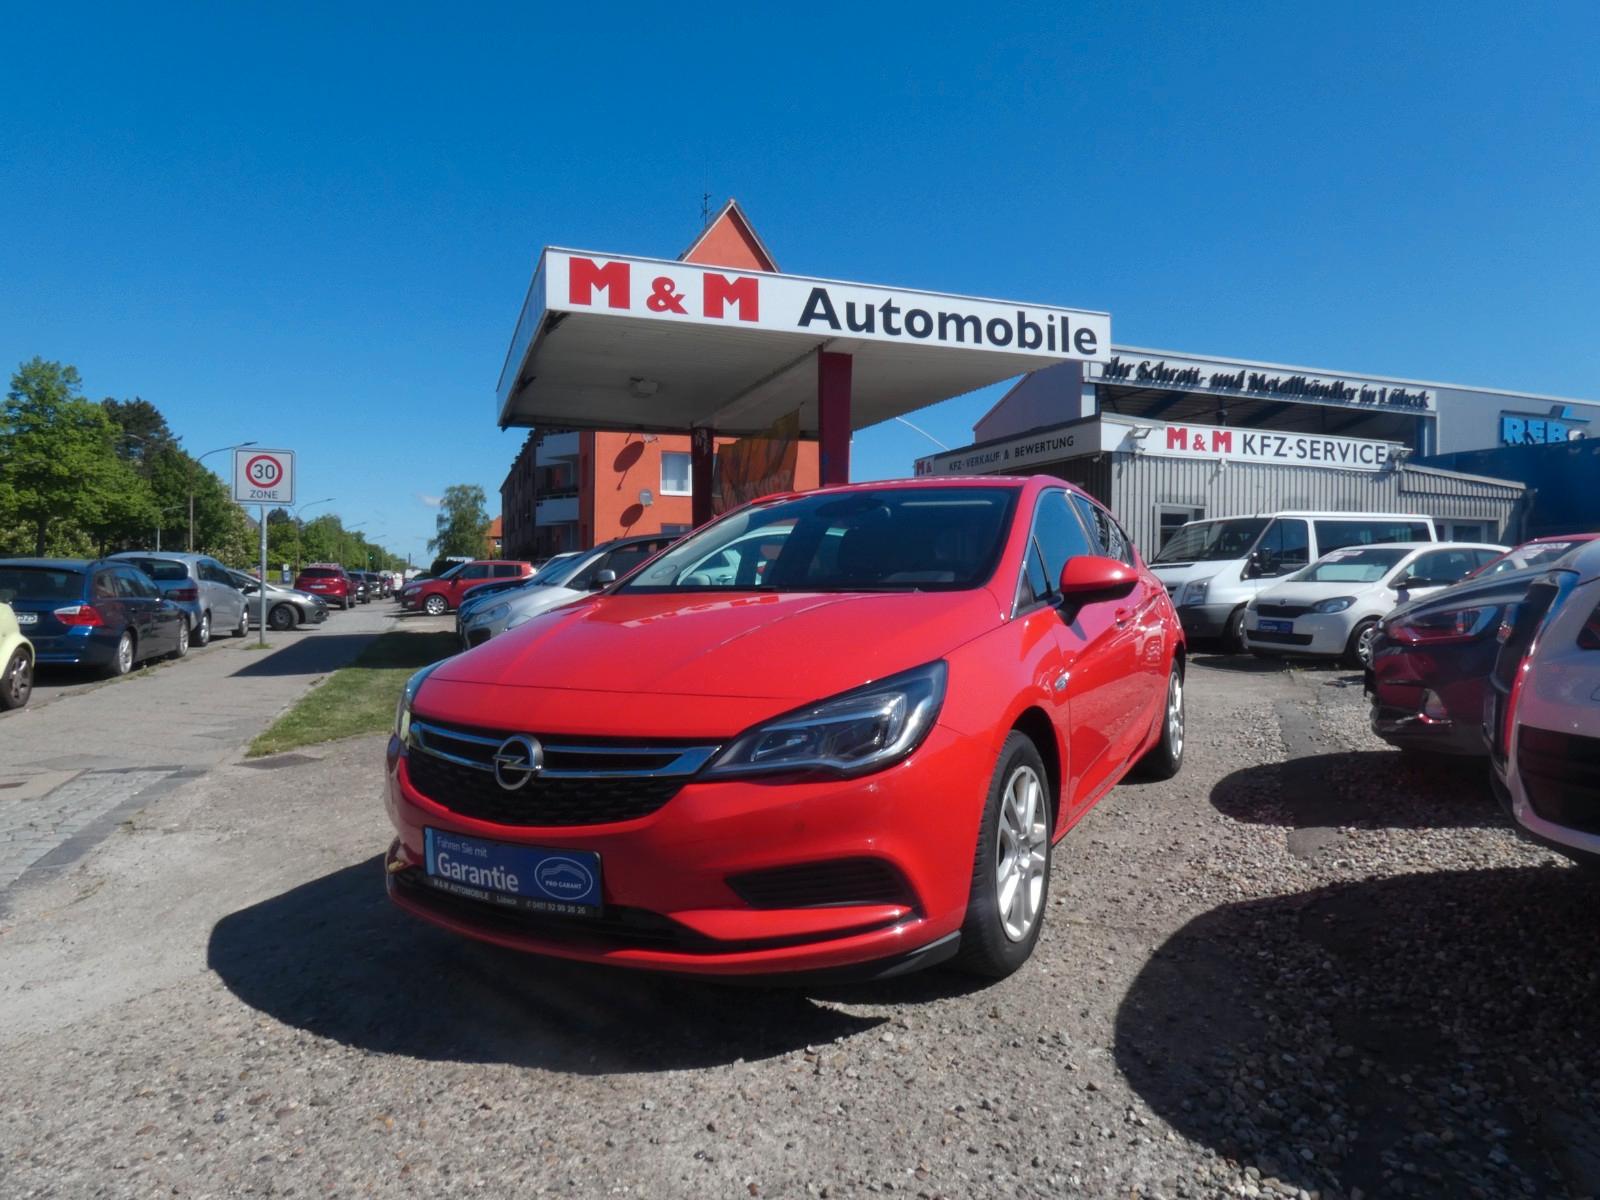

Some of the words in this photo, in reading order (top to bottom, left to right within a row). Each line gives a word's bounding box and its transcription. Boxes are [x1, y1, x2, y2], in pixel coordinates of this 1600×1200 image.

[569, 257, 631, 309] M
[646, 276, 689, 315] &
[703, 272, 759, 322] M
[797, 287, 1098, 355] Automobile
[1166, 427, 1188, 450] M
[1192, 433, 1207, 452] &
[1212, 430, 1232, 453] M
[949, 451, 1000, 472] KFZ-VERKAUF
[1014, 435, 1075, 458] BEWERTUNG
[254, 464, 275, 479] 30
[250, 490, 279, 499] ZONE
[474, 847, 488, 858] mit
[438, 852, 519, 892] Garantie
